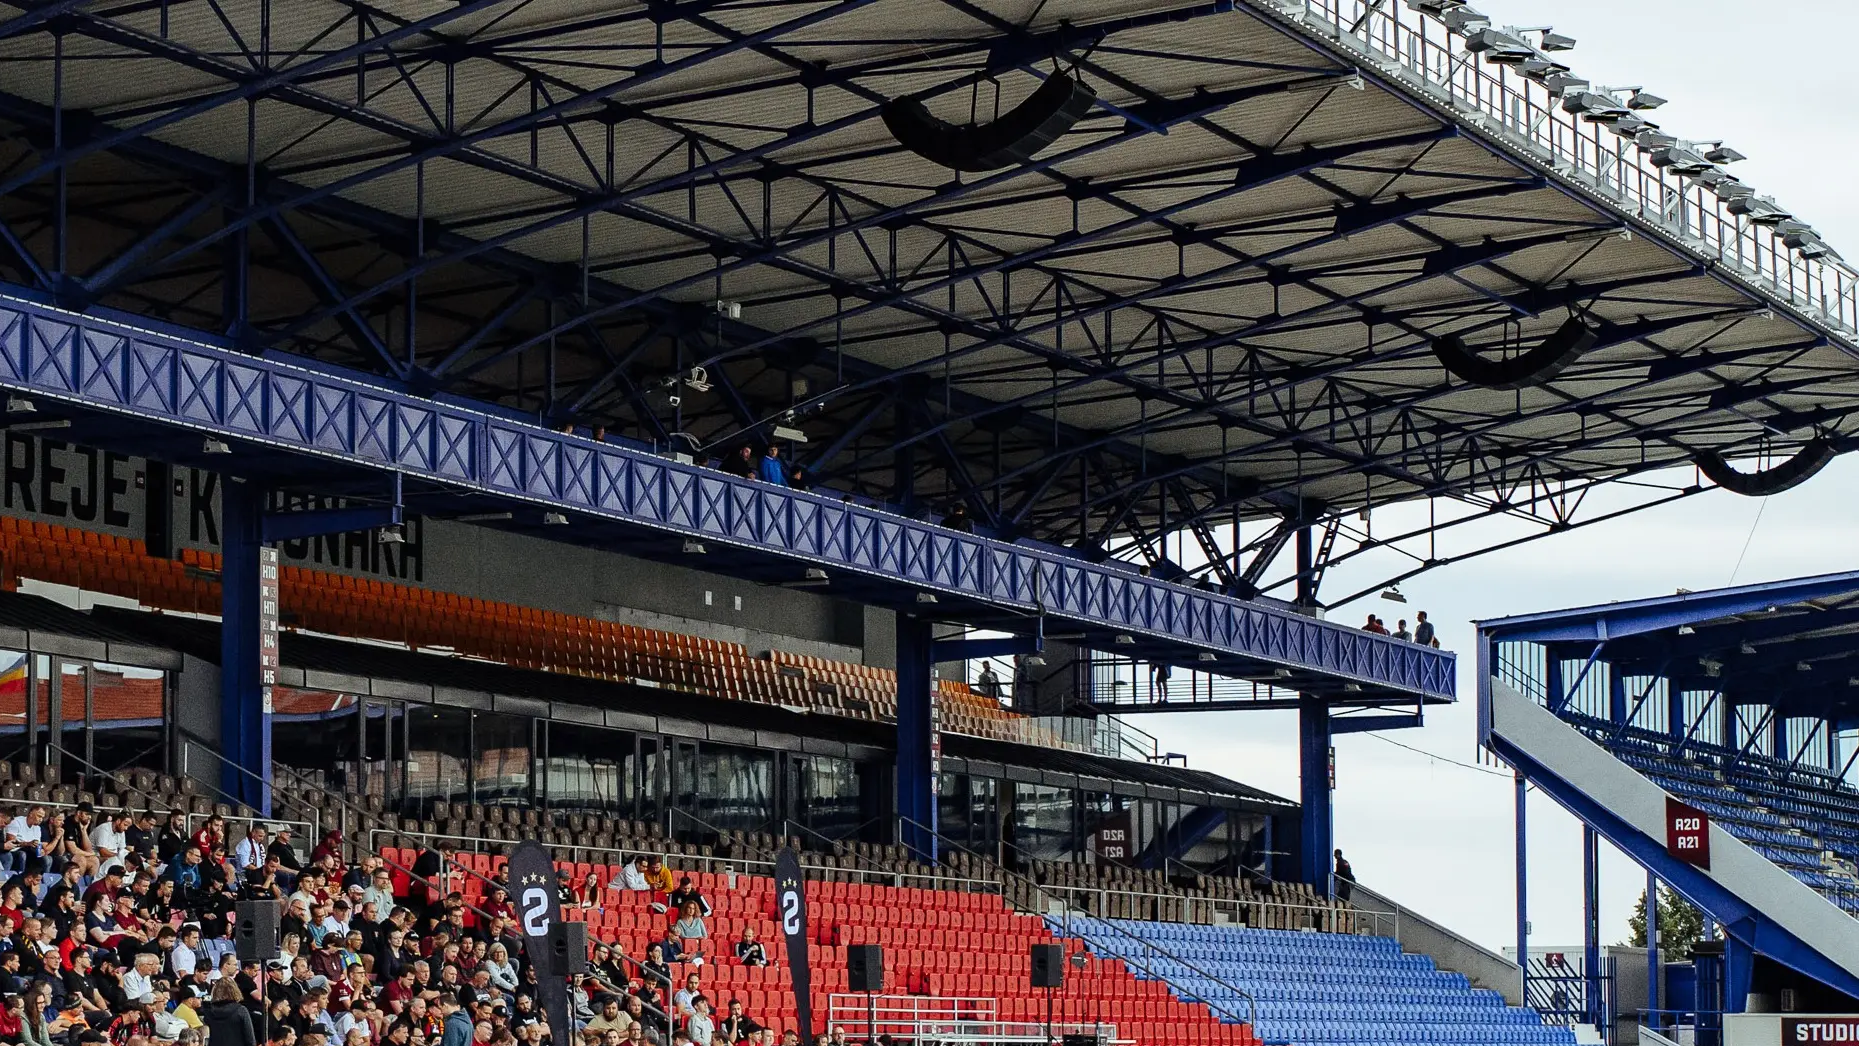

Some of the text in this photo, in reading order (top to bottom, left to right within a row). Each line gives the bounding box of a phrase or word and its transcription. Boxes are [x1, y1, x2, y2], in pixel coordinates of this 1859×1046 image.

[262, 564, 276, 580] H10
[263, 600, 275, 616] H11
[264, 634, 275, 649] H4
[263, 669, 275, 685] H5
[1675, 818, 1701, 831] A20
[1677, 834, 1699, 849] A21
[1796, 1023, 1859, 1041] STUDI
